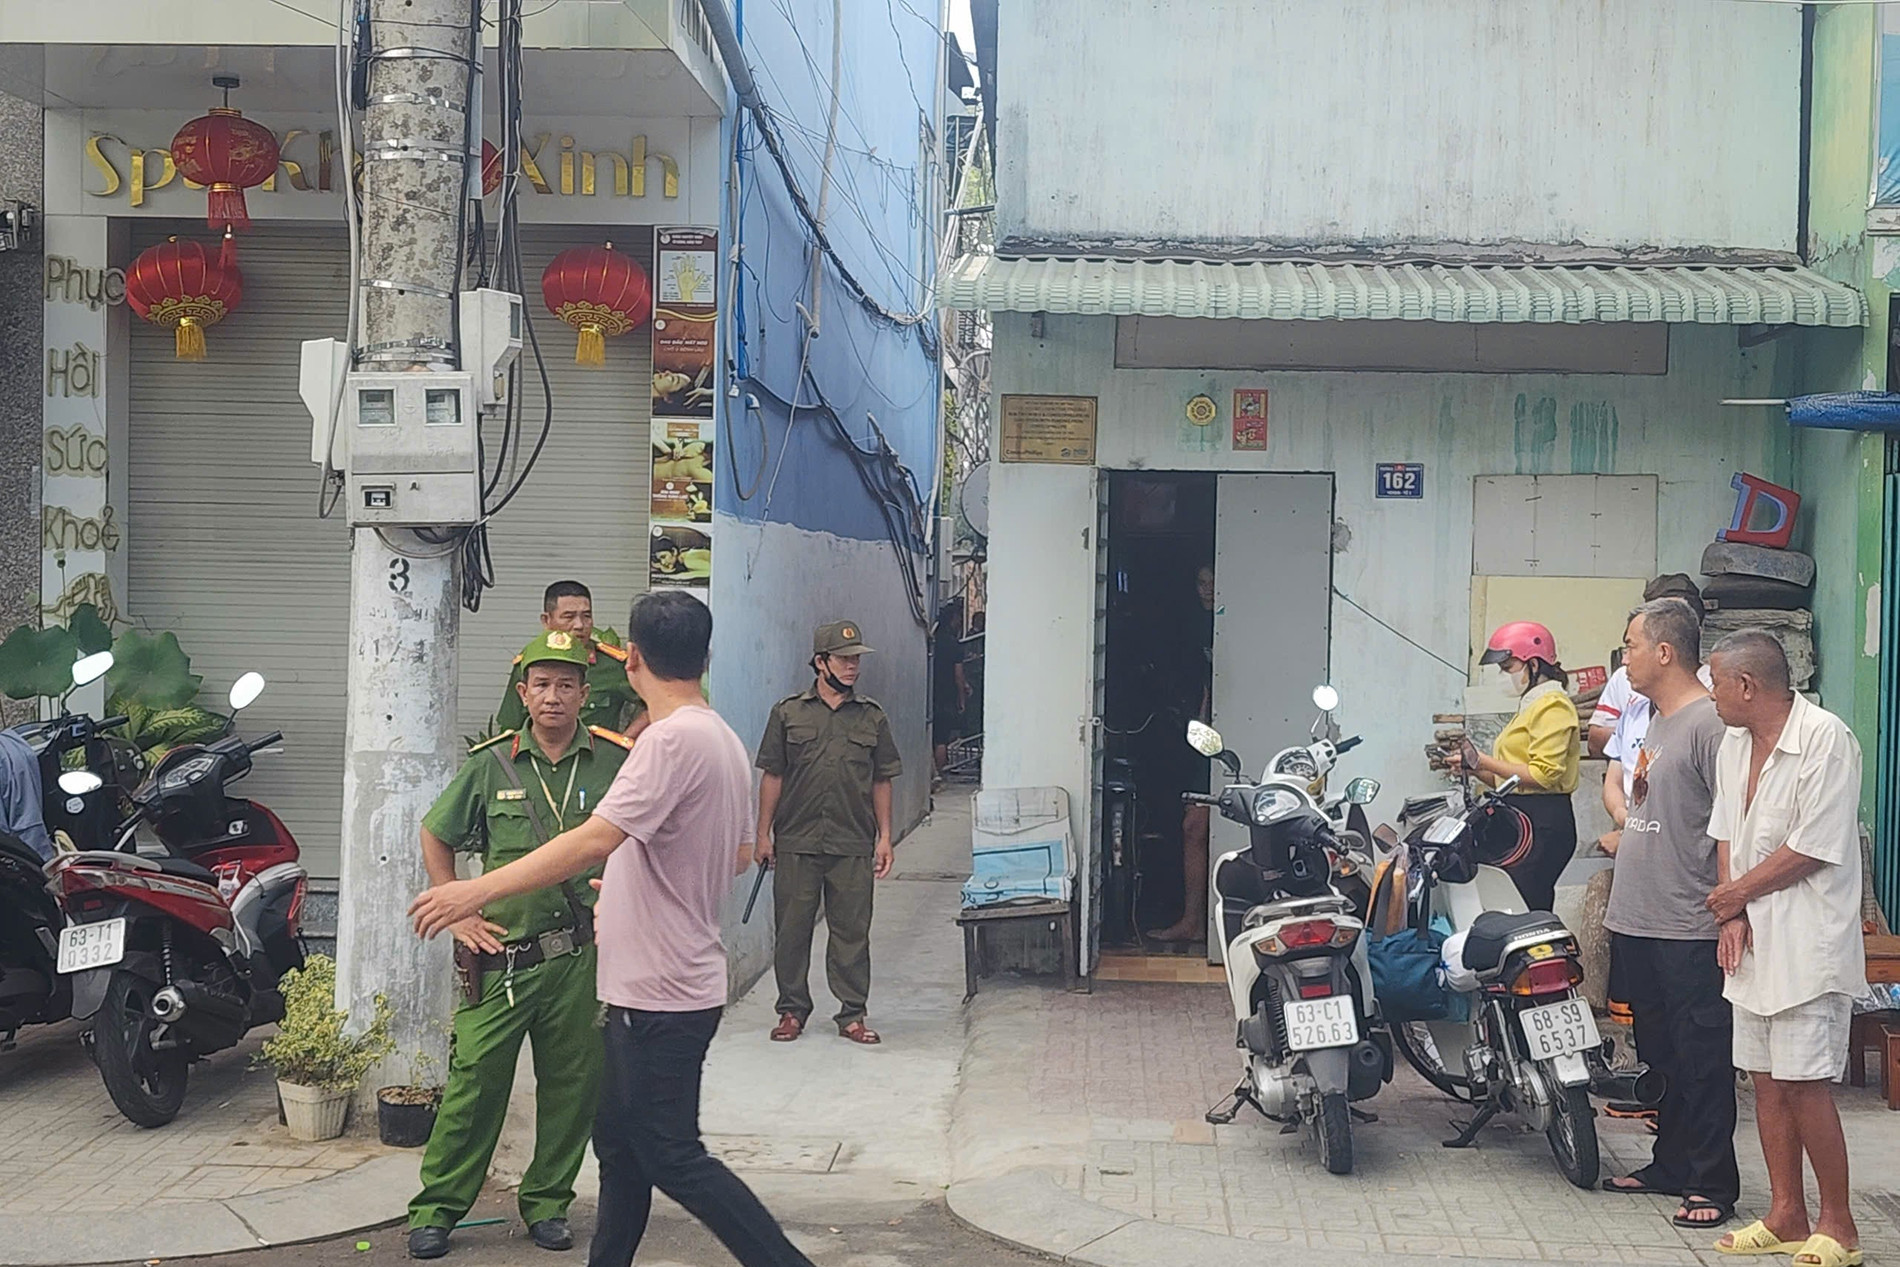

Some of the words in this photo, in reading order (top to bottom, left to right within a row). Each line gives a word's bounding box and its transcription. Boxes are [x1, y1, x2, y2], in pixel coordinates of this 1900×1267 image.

[516, 133, 680, 198] Xinh
[45, 255, 126, 311] Phục
[46, 424, 108, 476] Sức
[1383, 472, 1416, 489] 162
[388, 557, 411, 593] 3
[69, 923, 112, 948] 63-T1
[68, 942, 113, 968] 0332
[1296, 1000, 1342, 1024] 63-C1
[1532, 1003, 1582, 1031] 68-S9
[1292, 1021, 1353, 1046] 526.63
[1539, 1024, 1586, 1053] 6537
